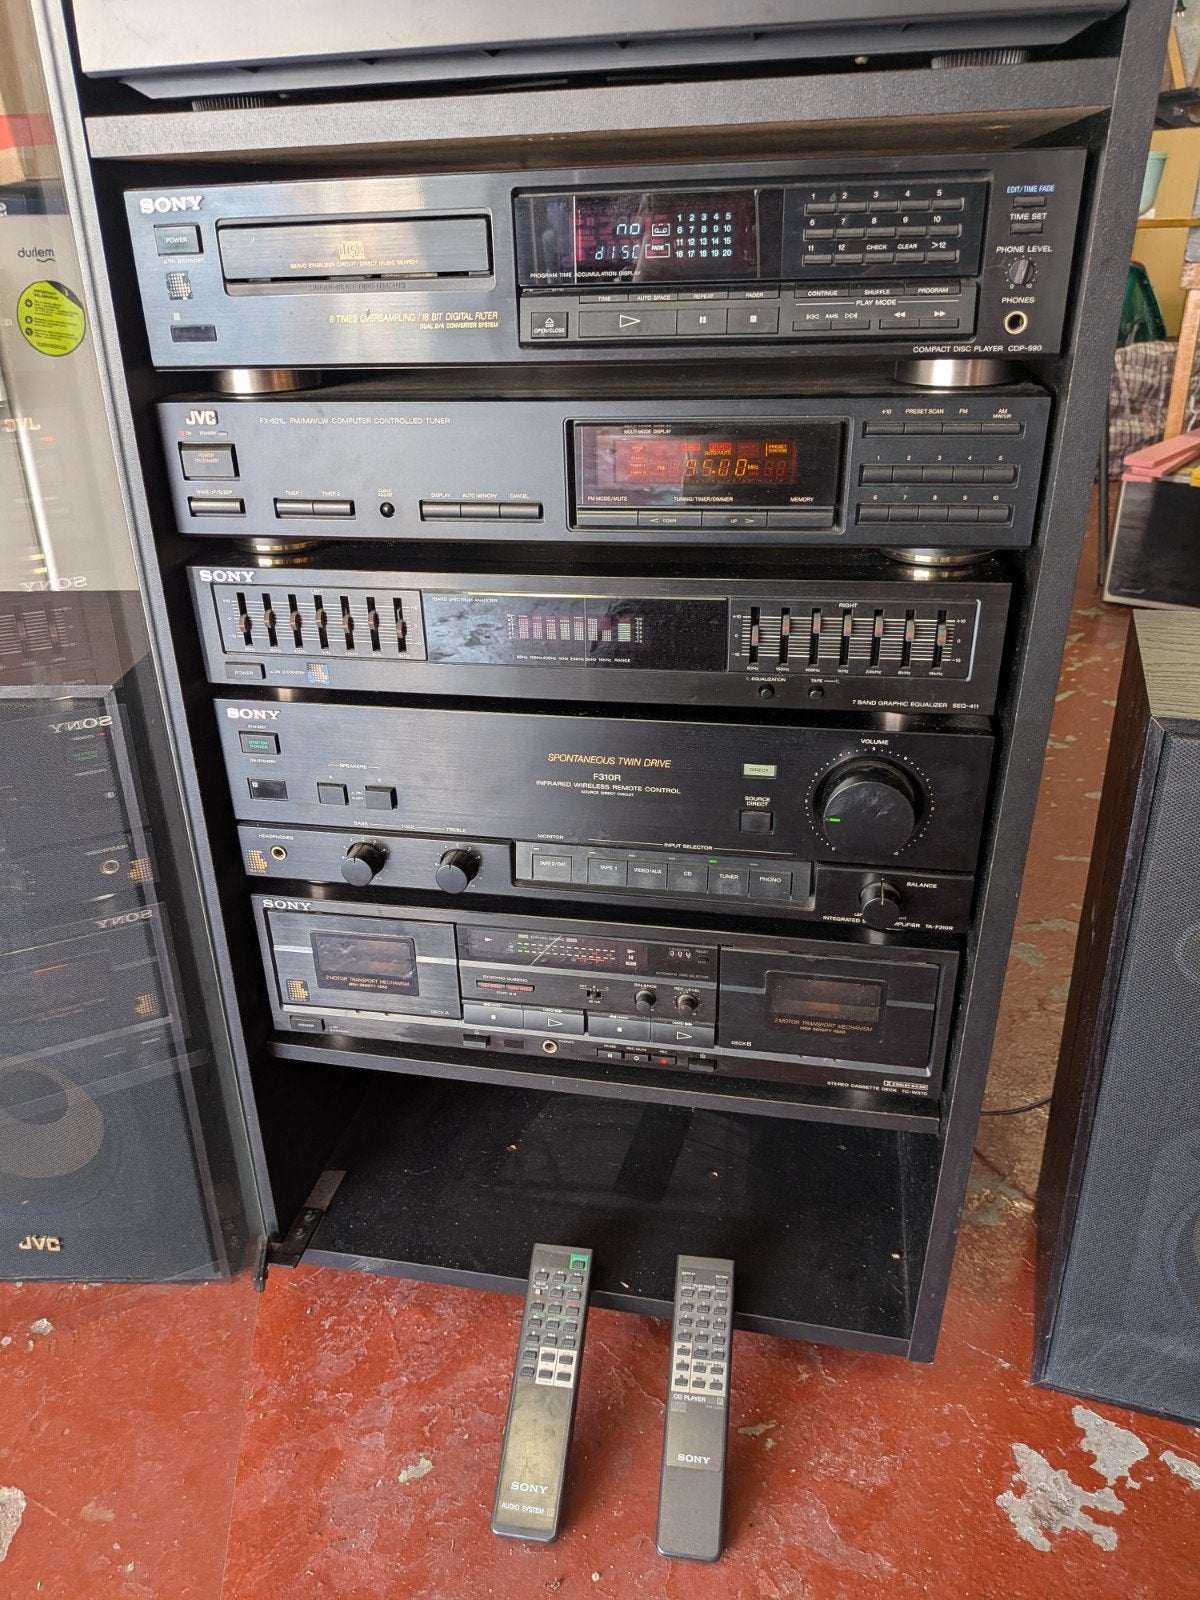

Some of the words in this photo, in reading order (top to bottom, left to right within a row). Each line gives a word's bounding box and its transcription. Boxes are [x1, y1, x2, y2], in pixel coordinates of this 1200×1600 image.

[1006, 185, 1037, 193] EDIT/TIME
[139, 196, 204, 214] SONY
[676, 250, 683, 258] 16
[722, 249, 732, 257] 20
[336, 315, 357, 323] TIMES
[360, 314, 415, 322] OVERSAMPLING
[432, 313, 442, 321] BIT
[446, 312, 473, 320] DIGITAL
[475, 312, 498, 320] FILTER
[953, 345, 971, 353] DISC
[185, 410, 216, 425] JVC
[199, 570, 255, 582] SONY
[226, 708, 281, 720] SONY
[548, 753, 616, 765] SPONTANEOUS
[618, 757, 641, 766] TWIN
[643, 758, 671, 768] DRIVE
[593, 773, 621, 781] F310R
[536, 780, 571, 788] INFRARED
[573, 782, 610, 790] WIRELESS
[612, 784, 642, 792] REMOTE
[644, 786, 681, 794] CONTROL
[906, 881, 937, 889] BALANCE
[263, 900, 311, 910] SONY
[802, 1020, 836, 1029] TRANSPORT
[838, 1024, 872, 1032] MECHANISM
[851, 1083, 880, 1091] CASSETTE
[18, 1234, 61, 1252] JVC
[677, 1453, 711, 1464] SONY
[511, 1482, 548, 1494] SONY
[501, 1502, 519, 1511] AUDIO
[522, 1505, 544, 1514] SYSTEM
